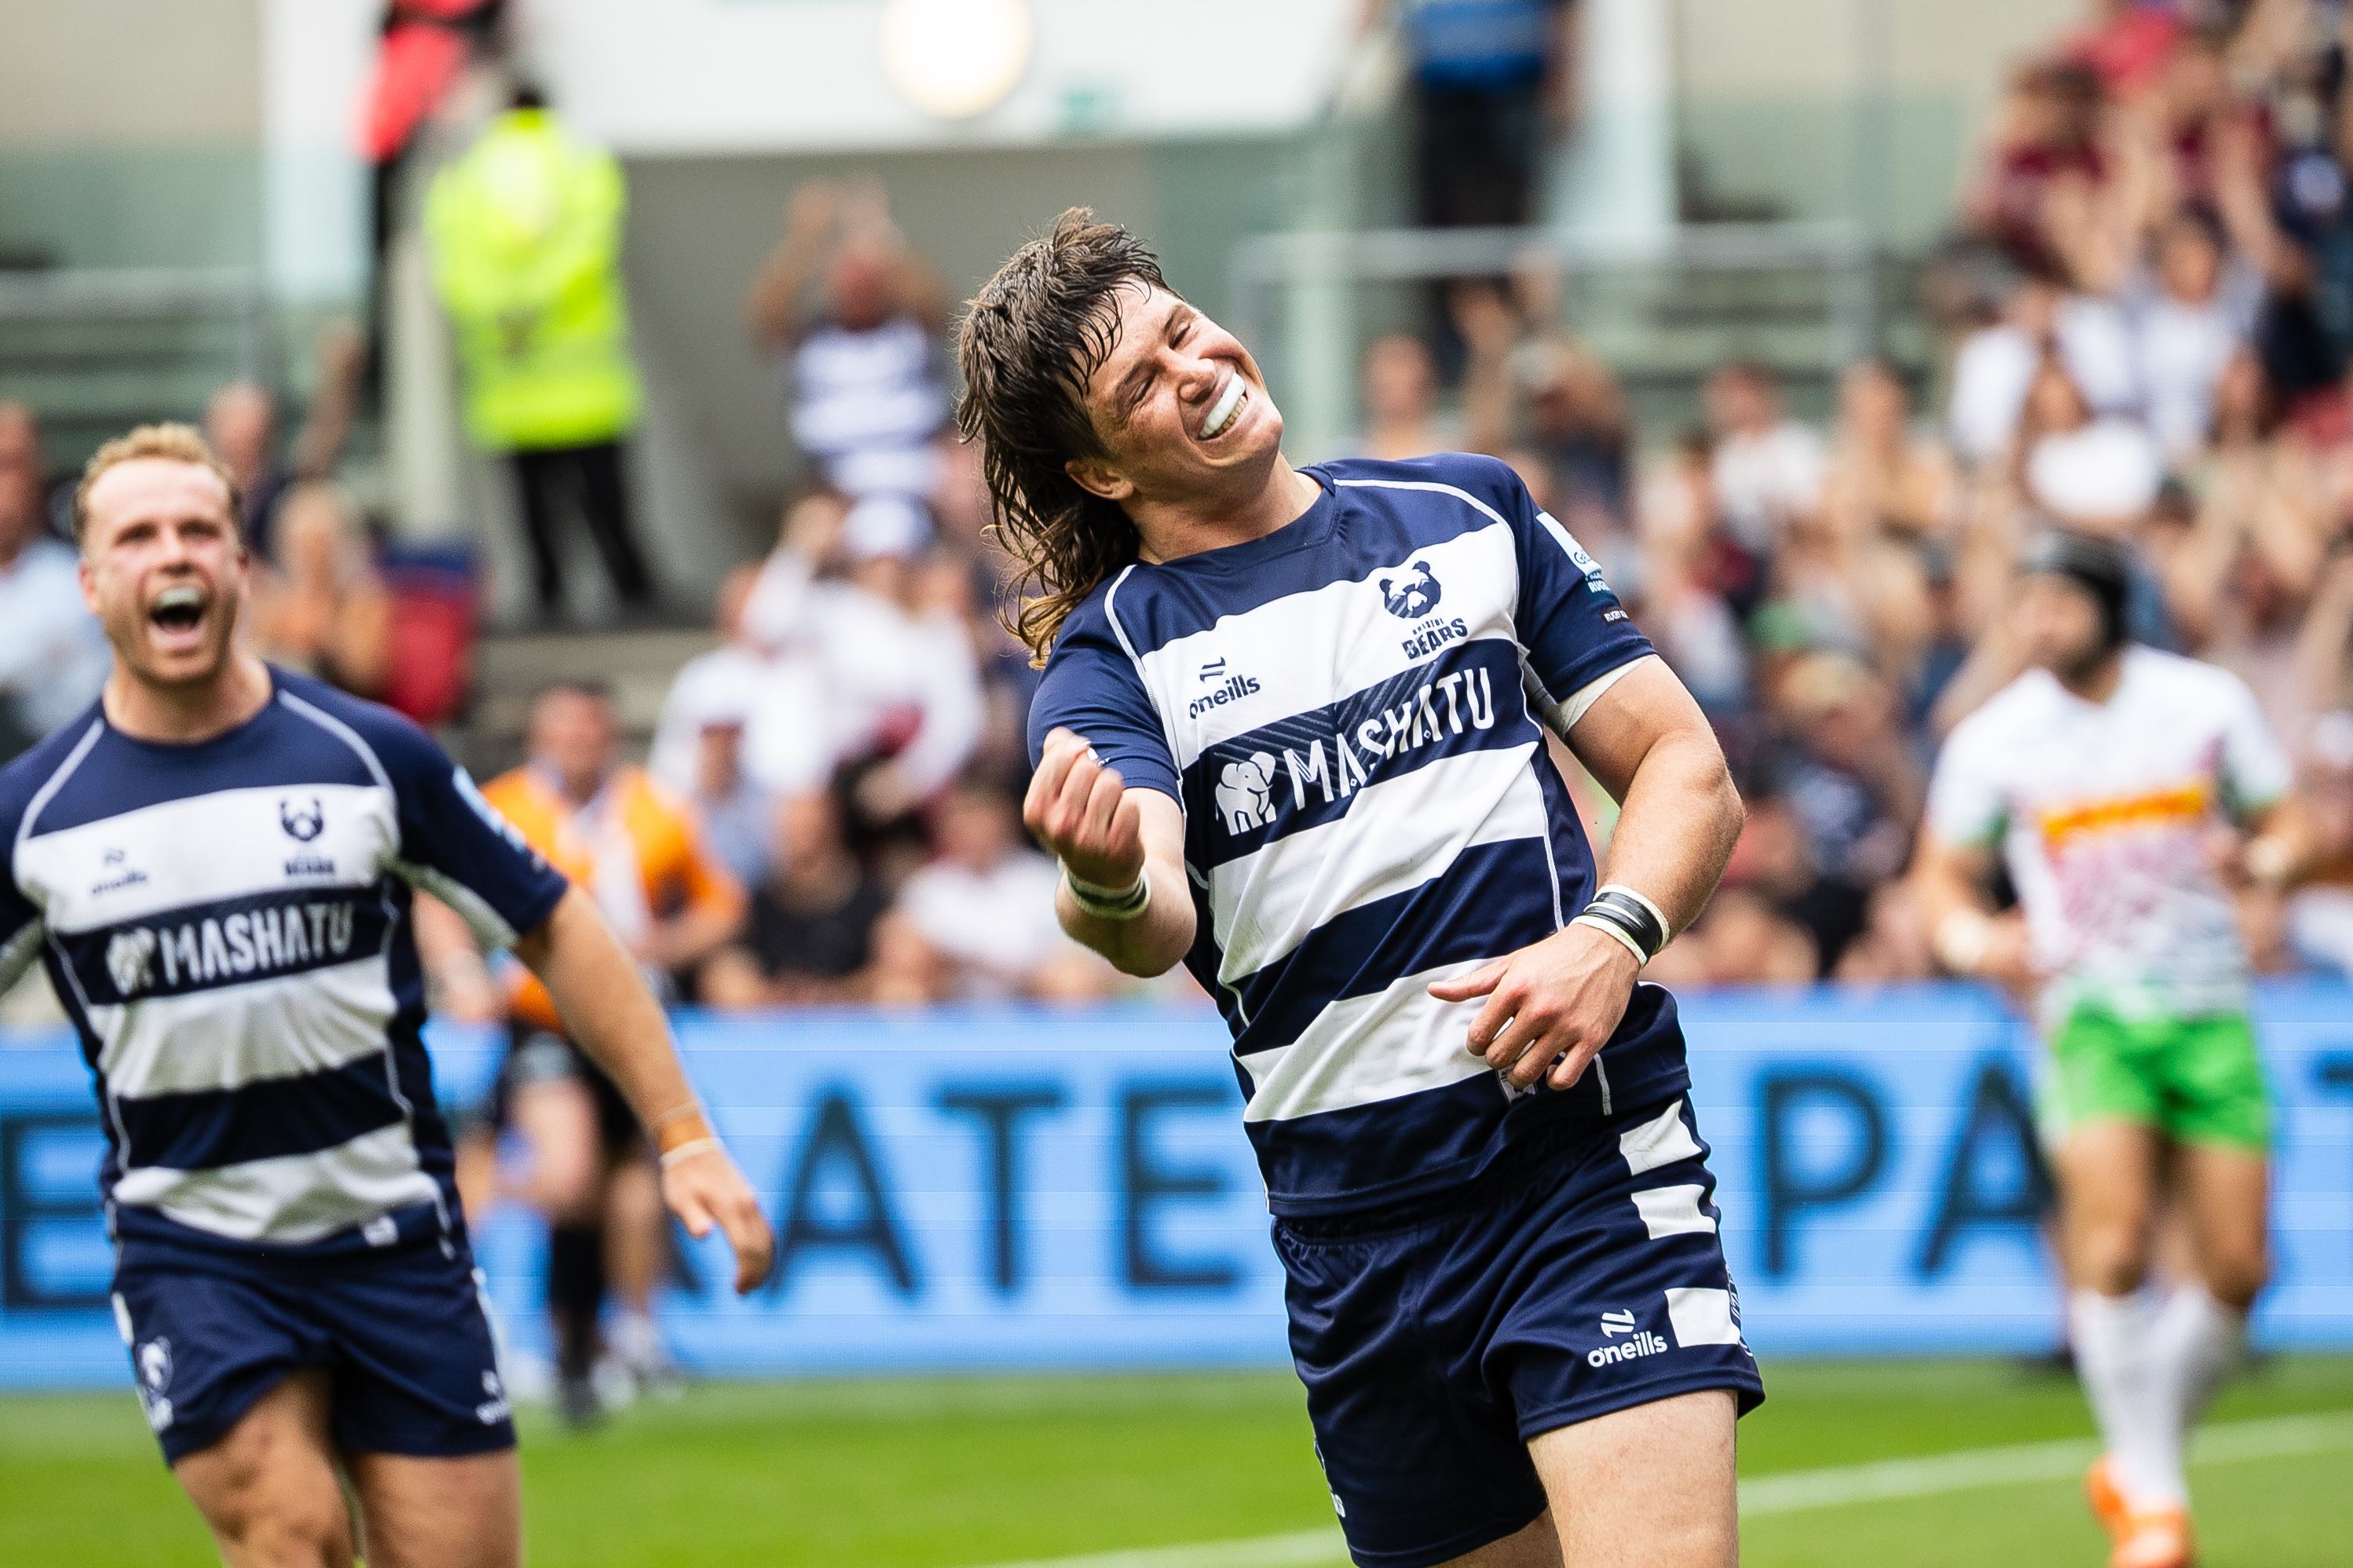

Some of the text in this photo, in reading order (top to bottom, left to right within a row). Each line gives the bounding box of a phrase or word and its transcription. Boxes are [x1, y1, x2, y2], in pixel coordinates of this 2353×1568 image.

[1401, 617, 1468, 660] BEARS
[1283, 667, 1495, 811] MASHATU
[159, 902, 353, 987] MASHATU
[677, 1074, 1244, 1296] ATE
